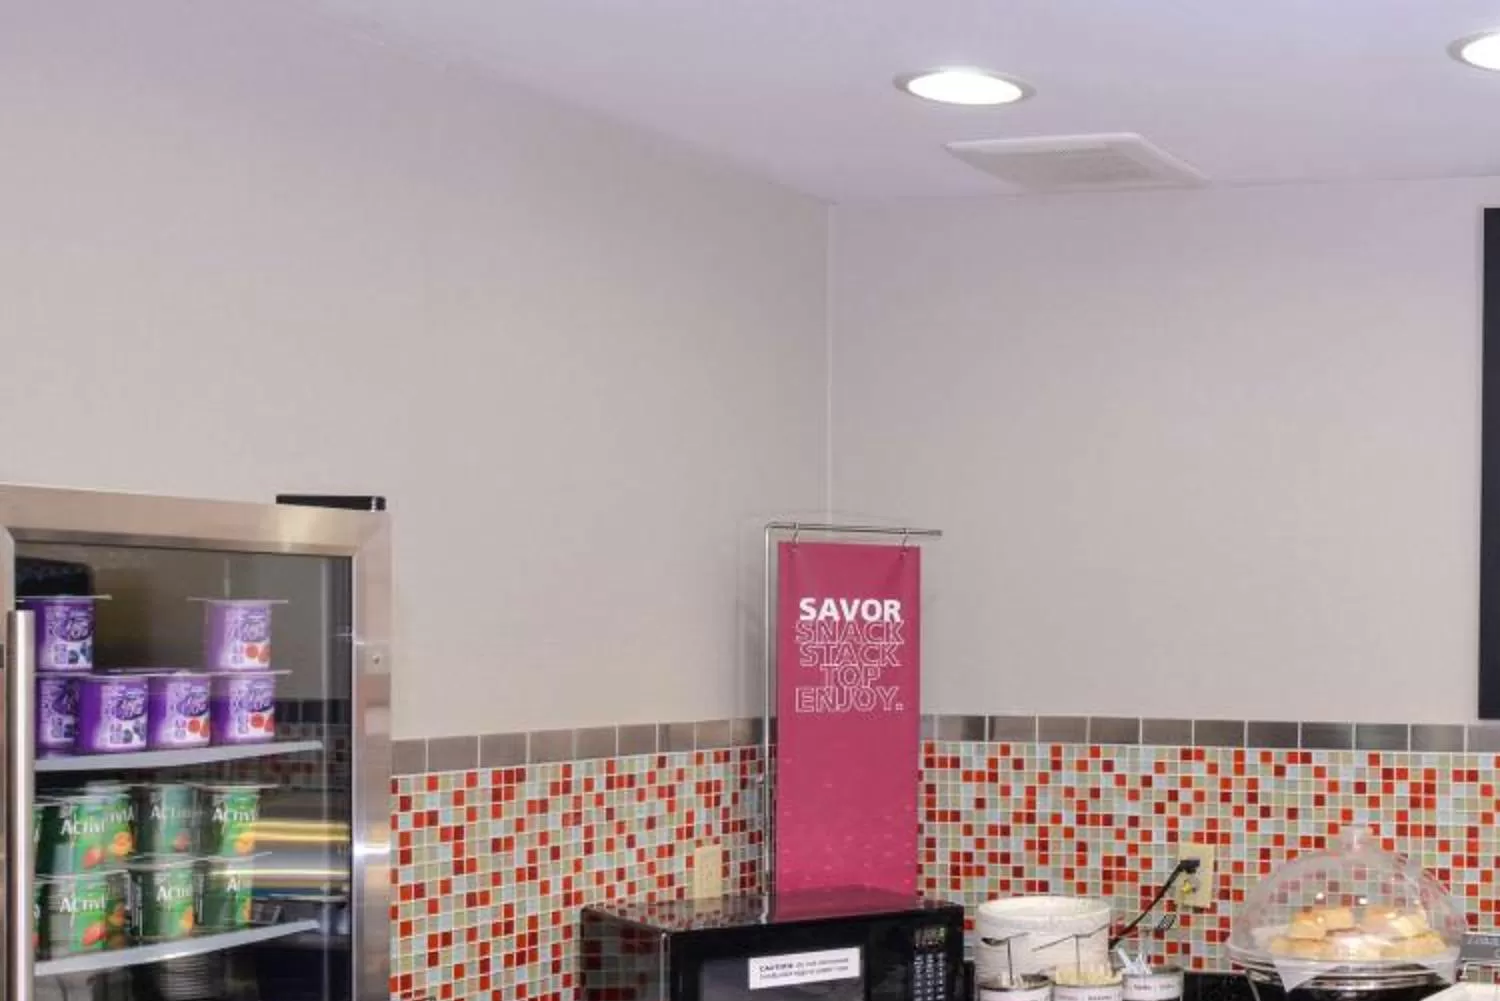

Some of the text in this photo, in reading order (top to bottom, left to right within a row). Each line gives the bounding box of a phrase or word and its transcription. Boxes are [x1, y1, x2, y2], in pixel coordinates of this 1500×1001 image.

[799, 597, 902, 622] SAVOR
[794, 620, 905, 644] SNACK
[799, 642, 903, 667] STACK
[820, 664, 881, 688] TOP
[795, 686, 904, 713] ENJOY.
